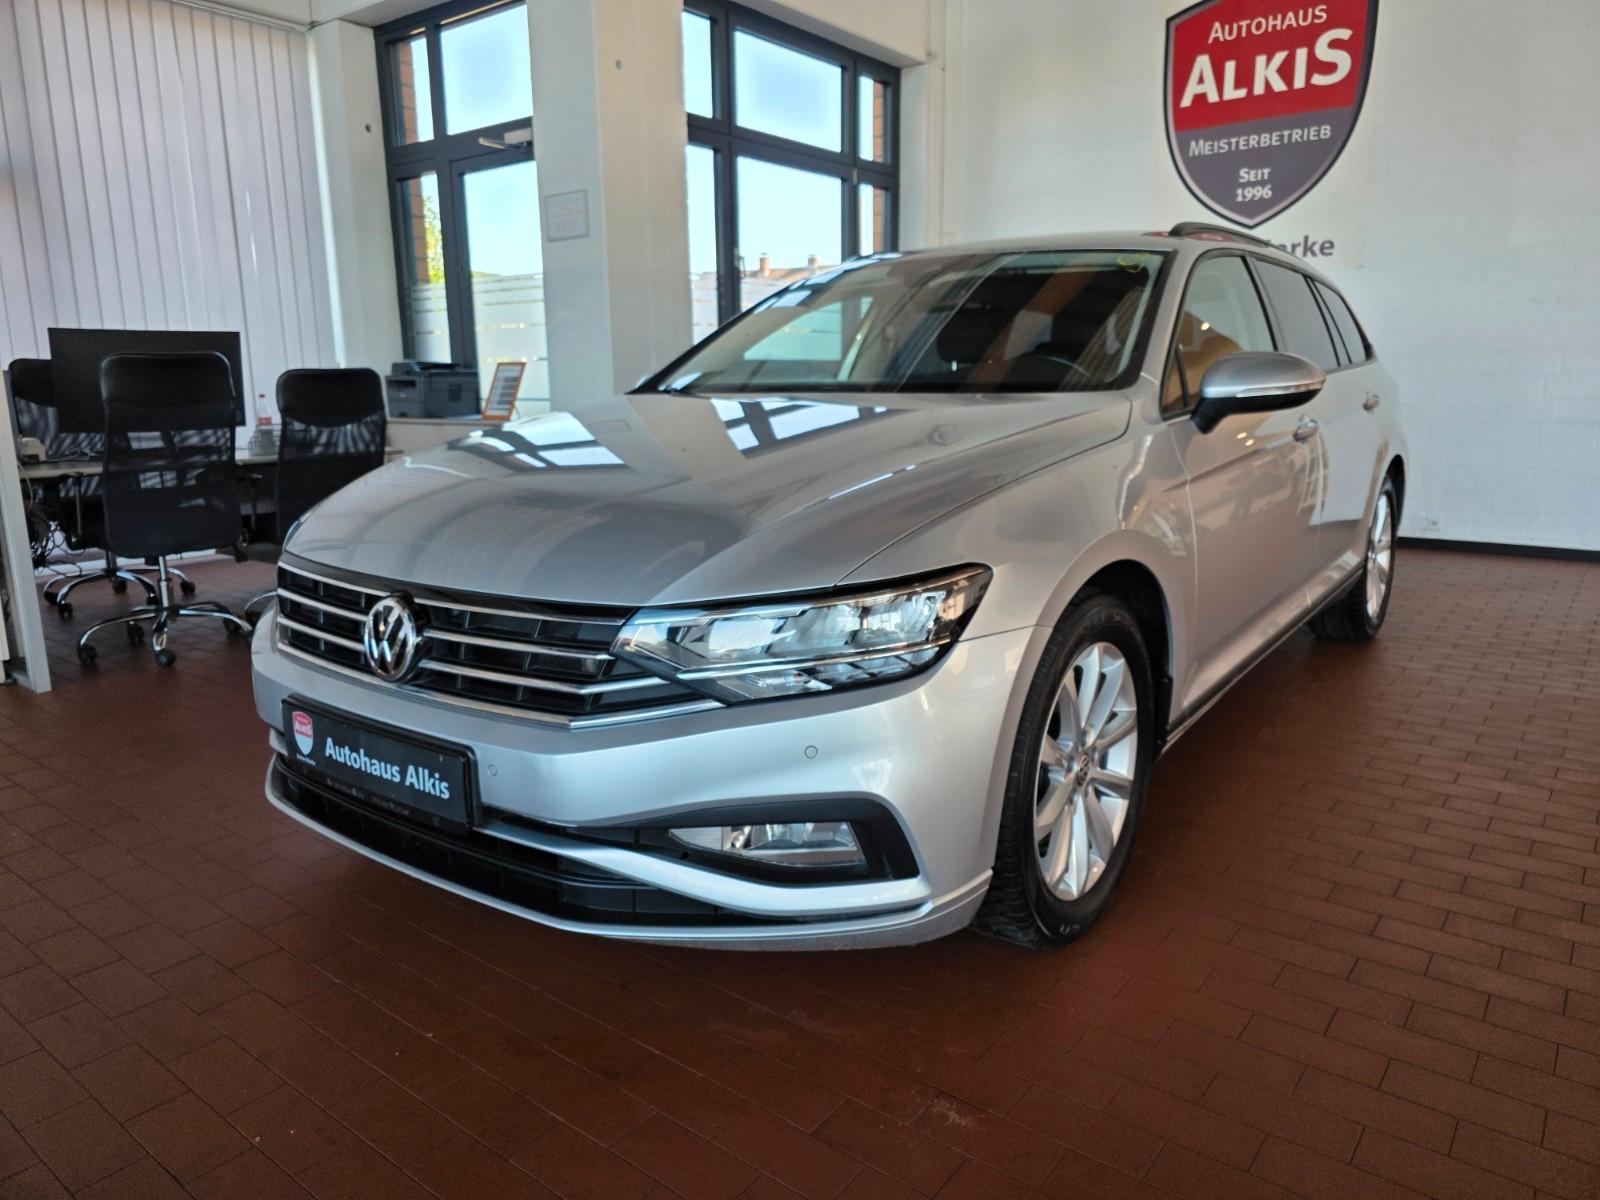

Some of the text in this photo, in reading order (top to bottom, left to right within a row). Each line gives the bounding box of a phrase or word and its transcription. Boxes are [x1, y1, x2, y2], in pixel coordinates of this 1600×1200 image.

[1207, 5, 1327, 44] AUTOHAUS
[1179, 28, 1353, 108] ALKIS
[1189, 125, 1331, 157] MEISTERBETRIEB
[1239, 168, 1271, 183] SEIT
[1236, 185, 1272, 202] 1996
[325, 737, 401, 783] Autohaus
[405, 764, 450, 800] Alkis
